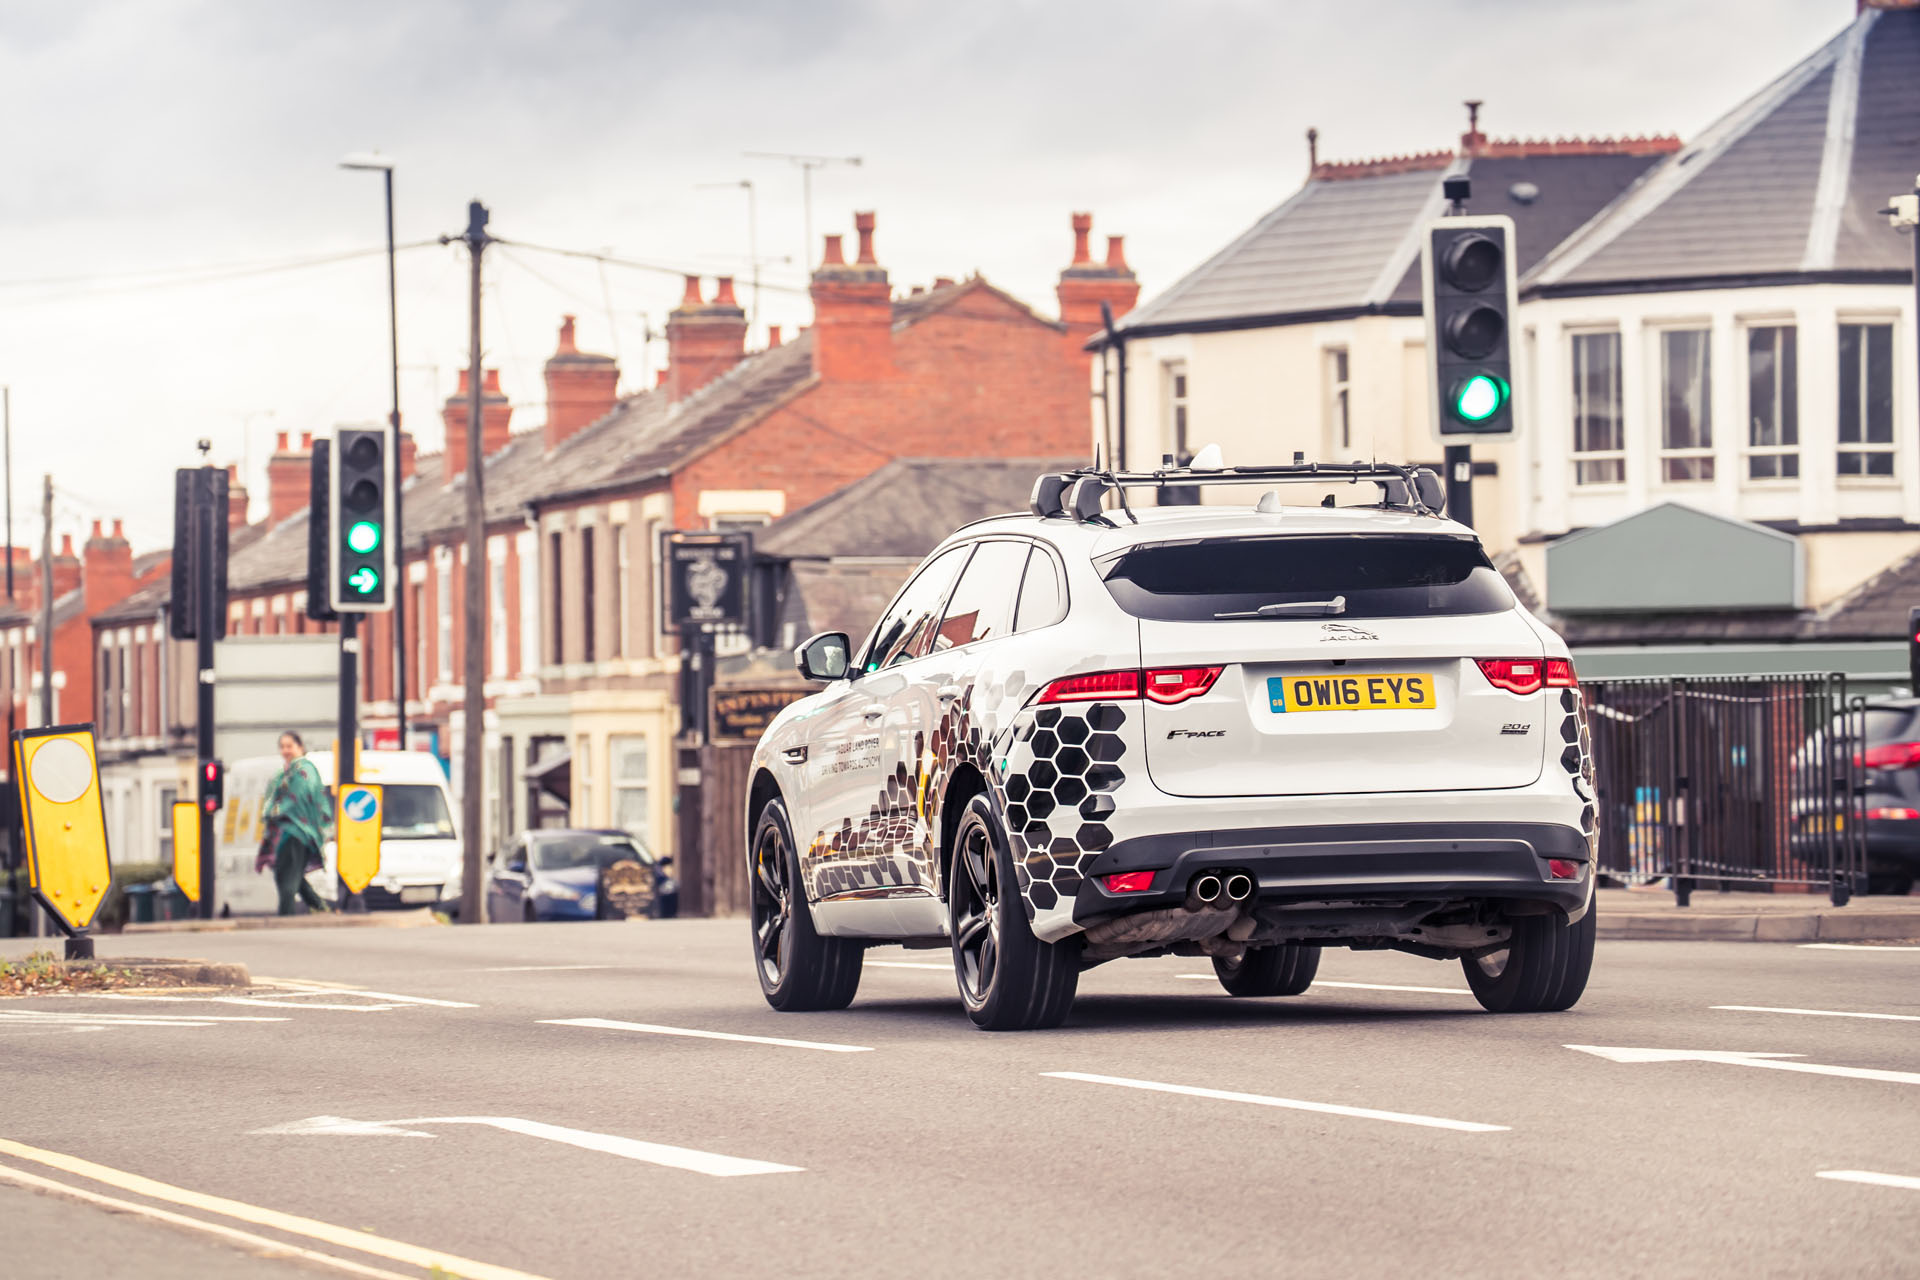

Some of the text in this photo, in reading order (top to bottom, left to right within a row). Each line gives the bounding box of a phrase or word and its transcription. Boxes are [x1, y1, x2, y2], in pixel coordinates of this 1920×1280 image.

[1294, 677, 1425, 707] OW16 EYS
[1272, 698, 1283, 707] GB
